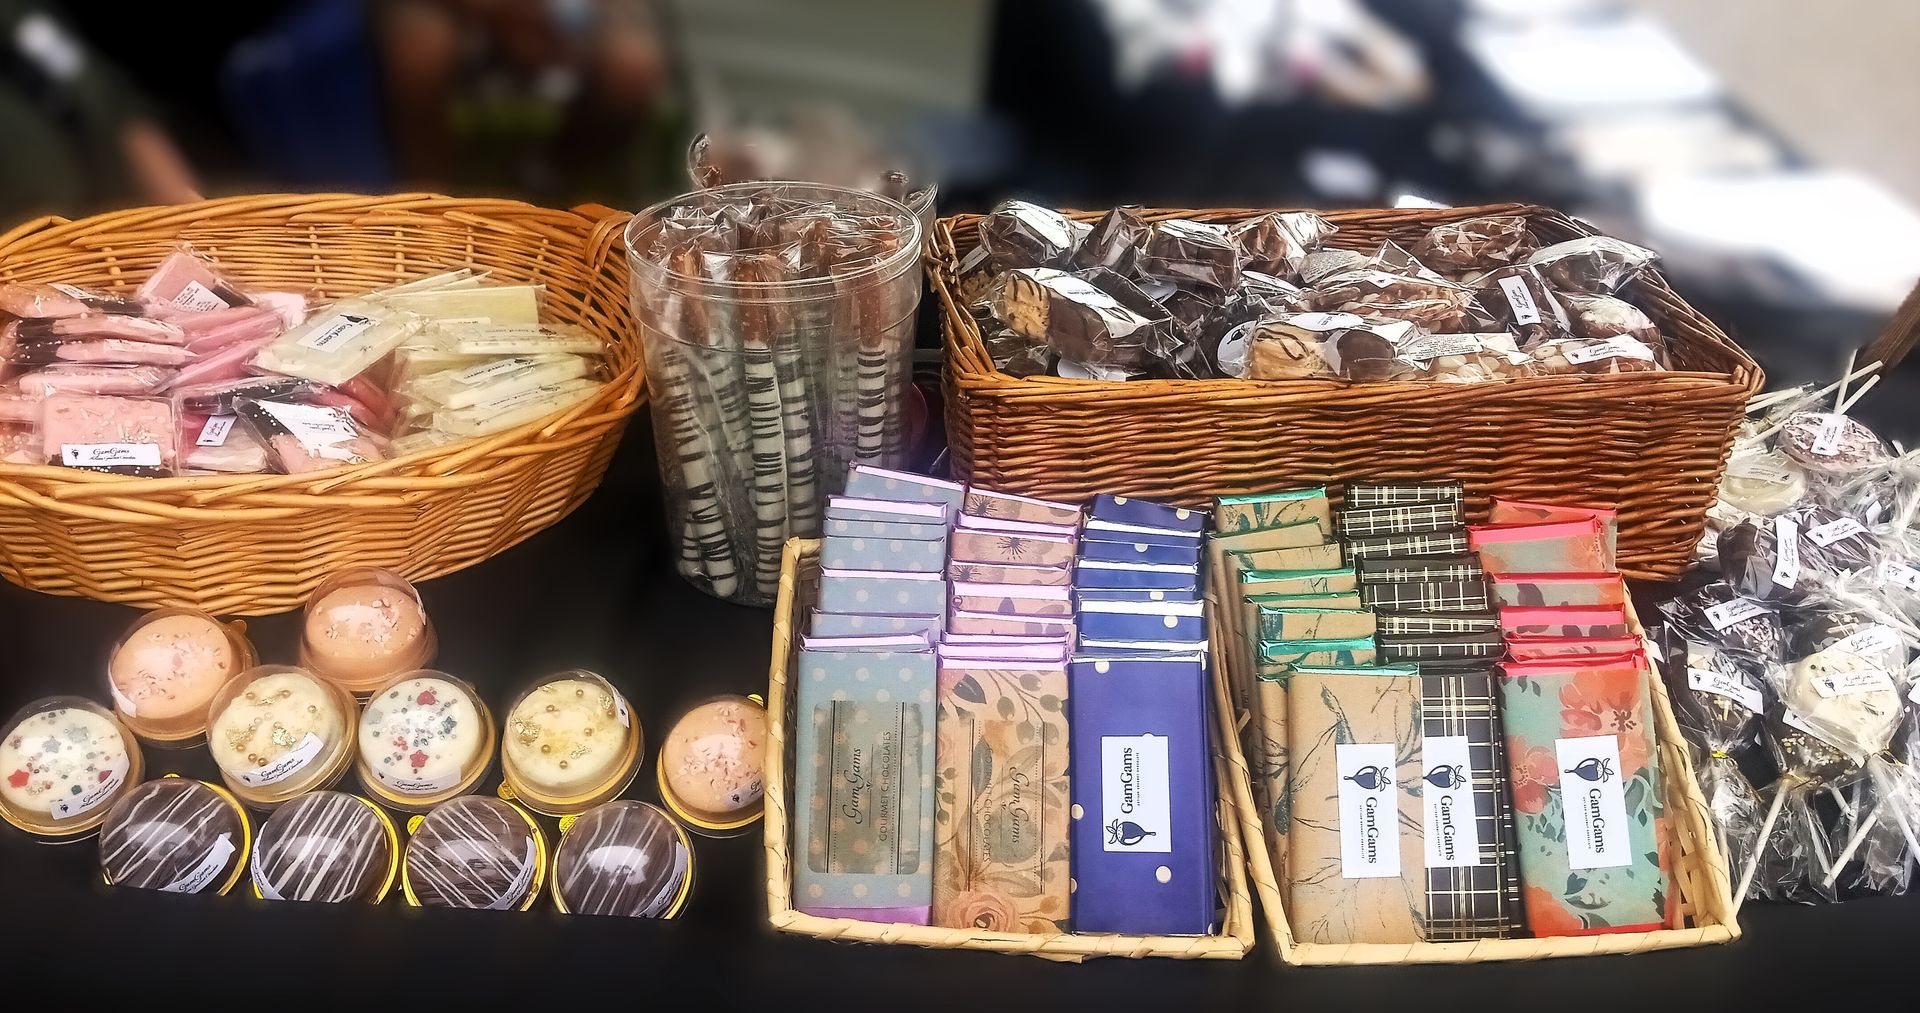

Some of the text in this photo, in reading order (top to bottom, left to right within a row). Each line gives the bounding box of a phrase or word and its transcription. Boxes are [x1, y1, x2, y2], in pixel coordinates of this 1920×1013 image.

[879, 731, 891, 842] GOURMET CHOCOLATES
[1120, 747, 1134, 814] GamGams
[982, 798, 993, 863] CHOCOLATES
[1366, 796, 1379, 864] GamGams
[1440, 795, 1456, 861] GamGams
[1589, 788, 1606, 853] GamGams
